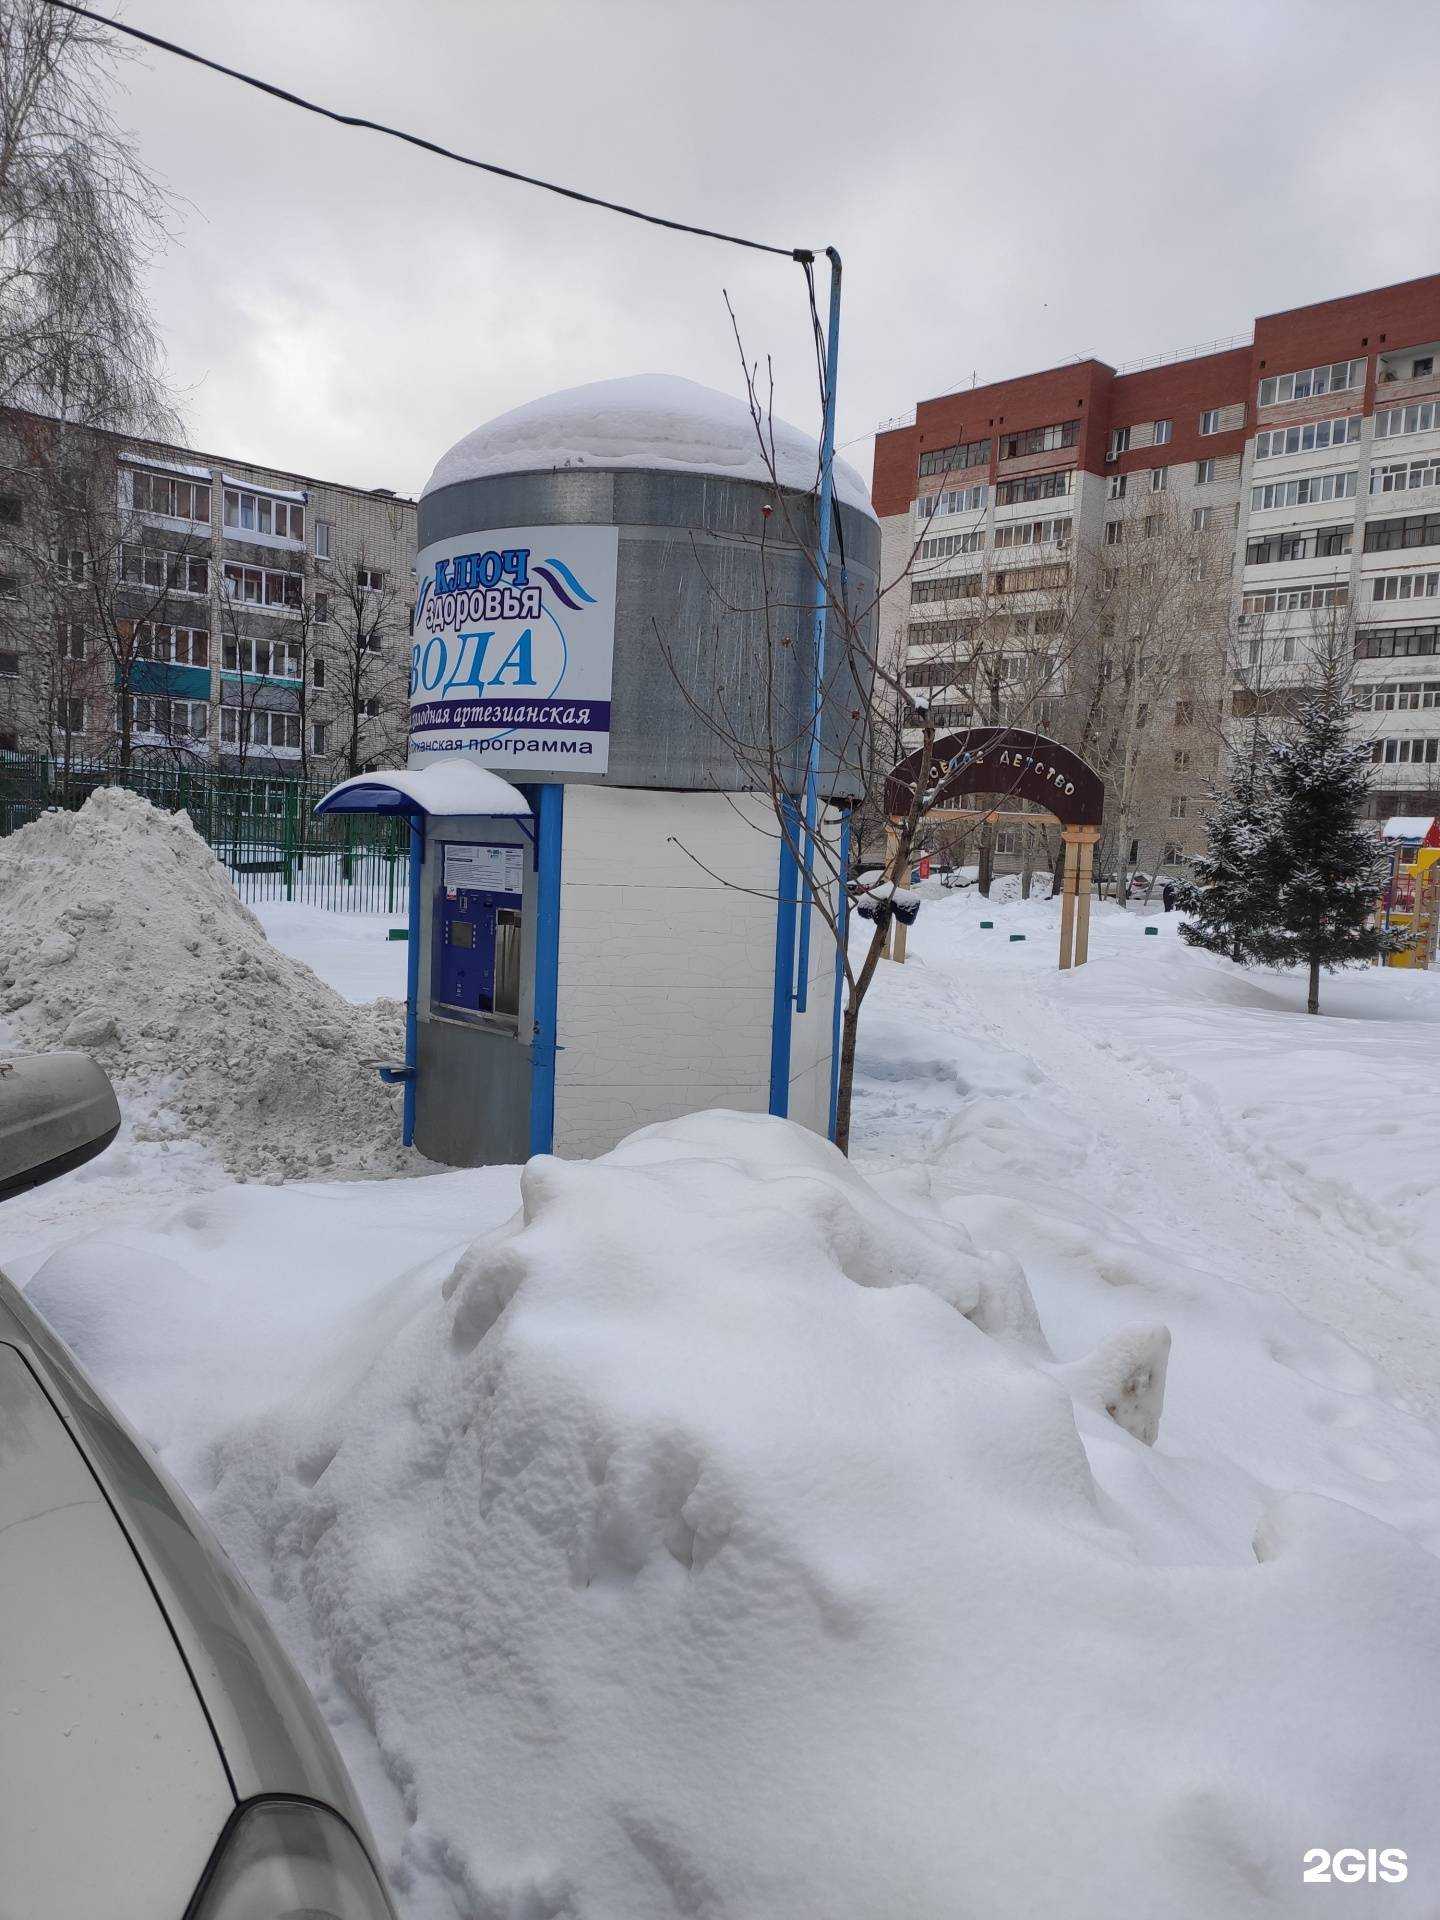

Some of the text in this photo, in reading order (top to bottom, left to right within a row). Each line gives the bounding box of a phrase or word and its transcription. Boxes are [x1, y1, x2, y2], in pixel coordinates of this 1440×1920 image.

[410, 628, 537, 699] ВОДА
[453, 704, 591, 728] артезианская
[468, 737, 593, 755] программа
